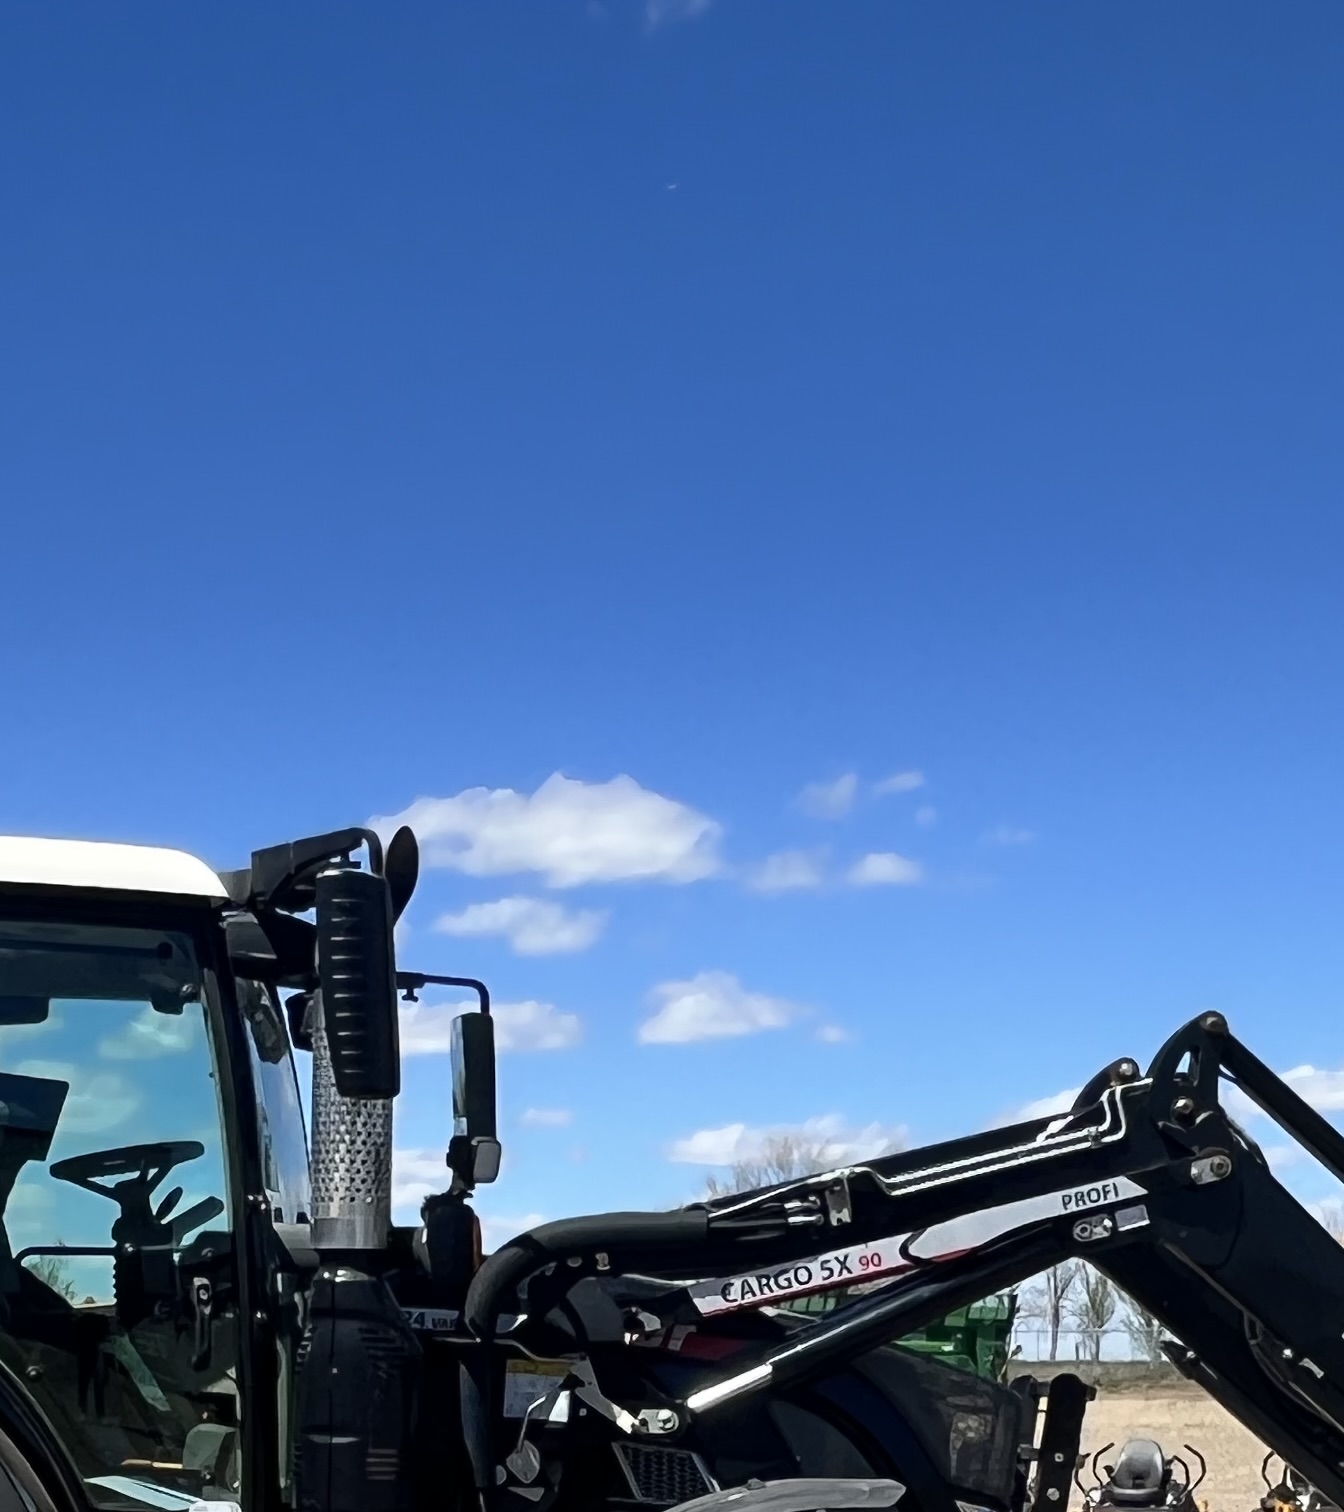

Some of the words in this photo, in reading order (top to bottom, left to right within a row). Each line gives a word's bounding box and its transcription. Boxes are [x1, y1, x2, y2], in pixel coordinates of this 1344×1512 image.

[1061, 1183, 1120, 1210] PROFI
[721, 1264, 812, 1304] CARGO
[820, 1252, 854, 1281] 5X
[859, 1253, 882, 1272] 90
